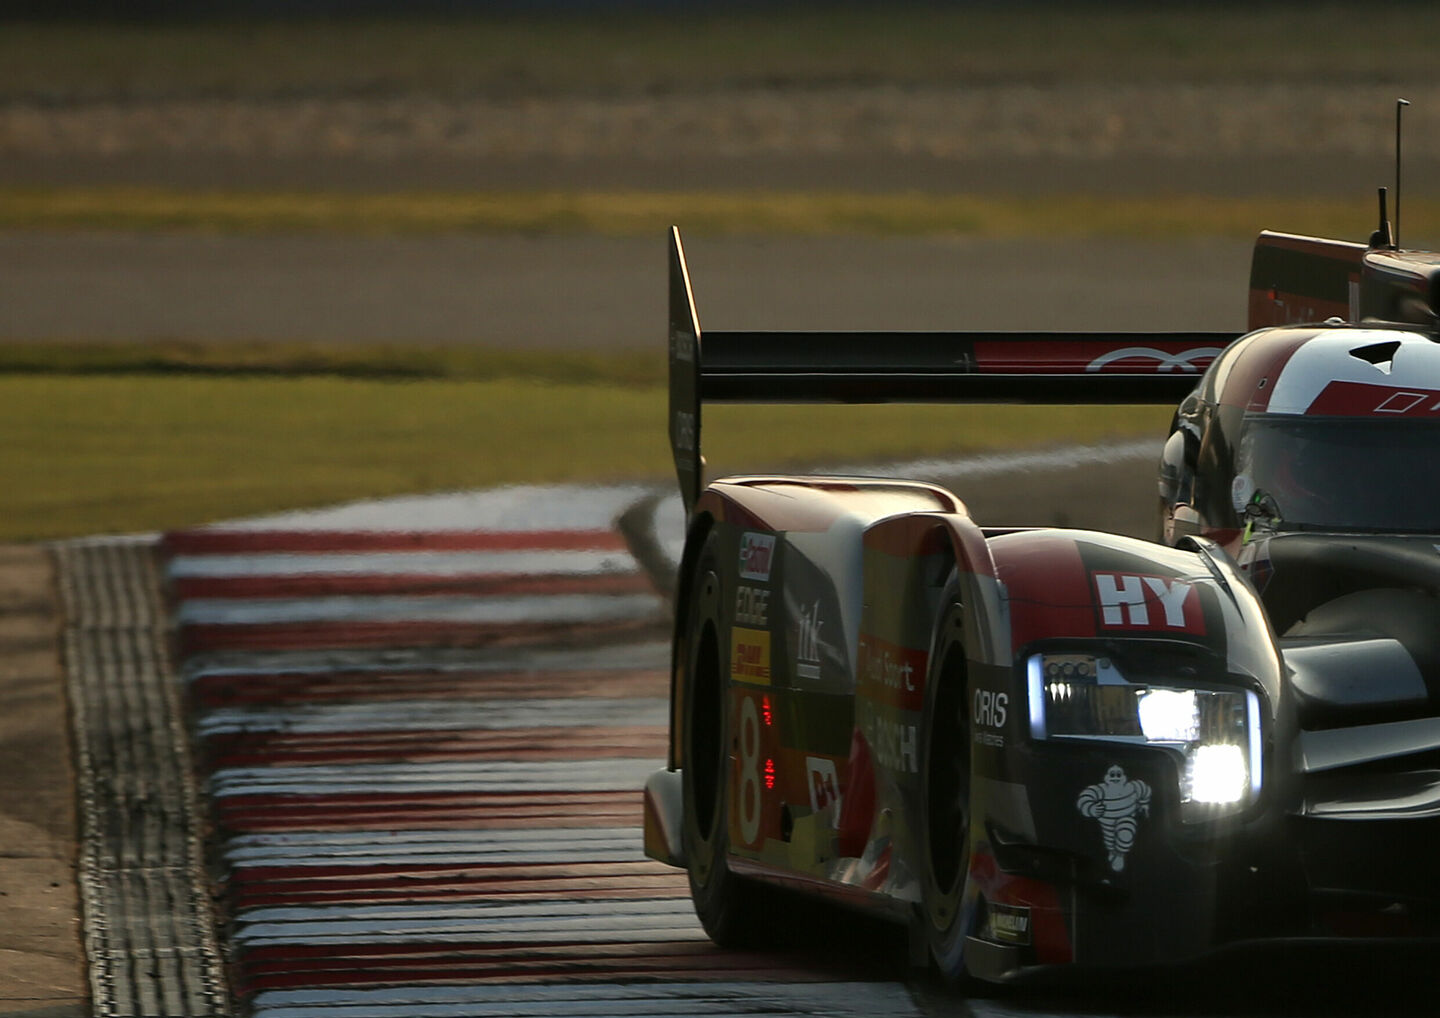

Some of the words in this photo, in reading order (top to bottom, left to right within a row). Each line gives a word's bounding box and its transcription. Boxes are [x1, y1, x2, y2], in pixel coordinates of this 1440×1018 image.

[1095, 574, 1191, 628] HY
[974, 688, 1009, 728] ORIS
[739, 695, 761, 845] 8
